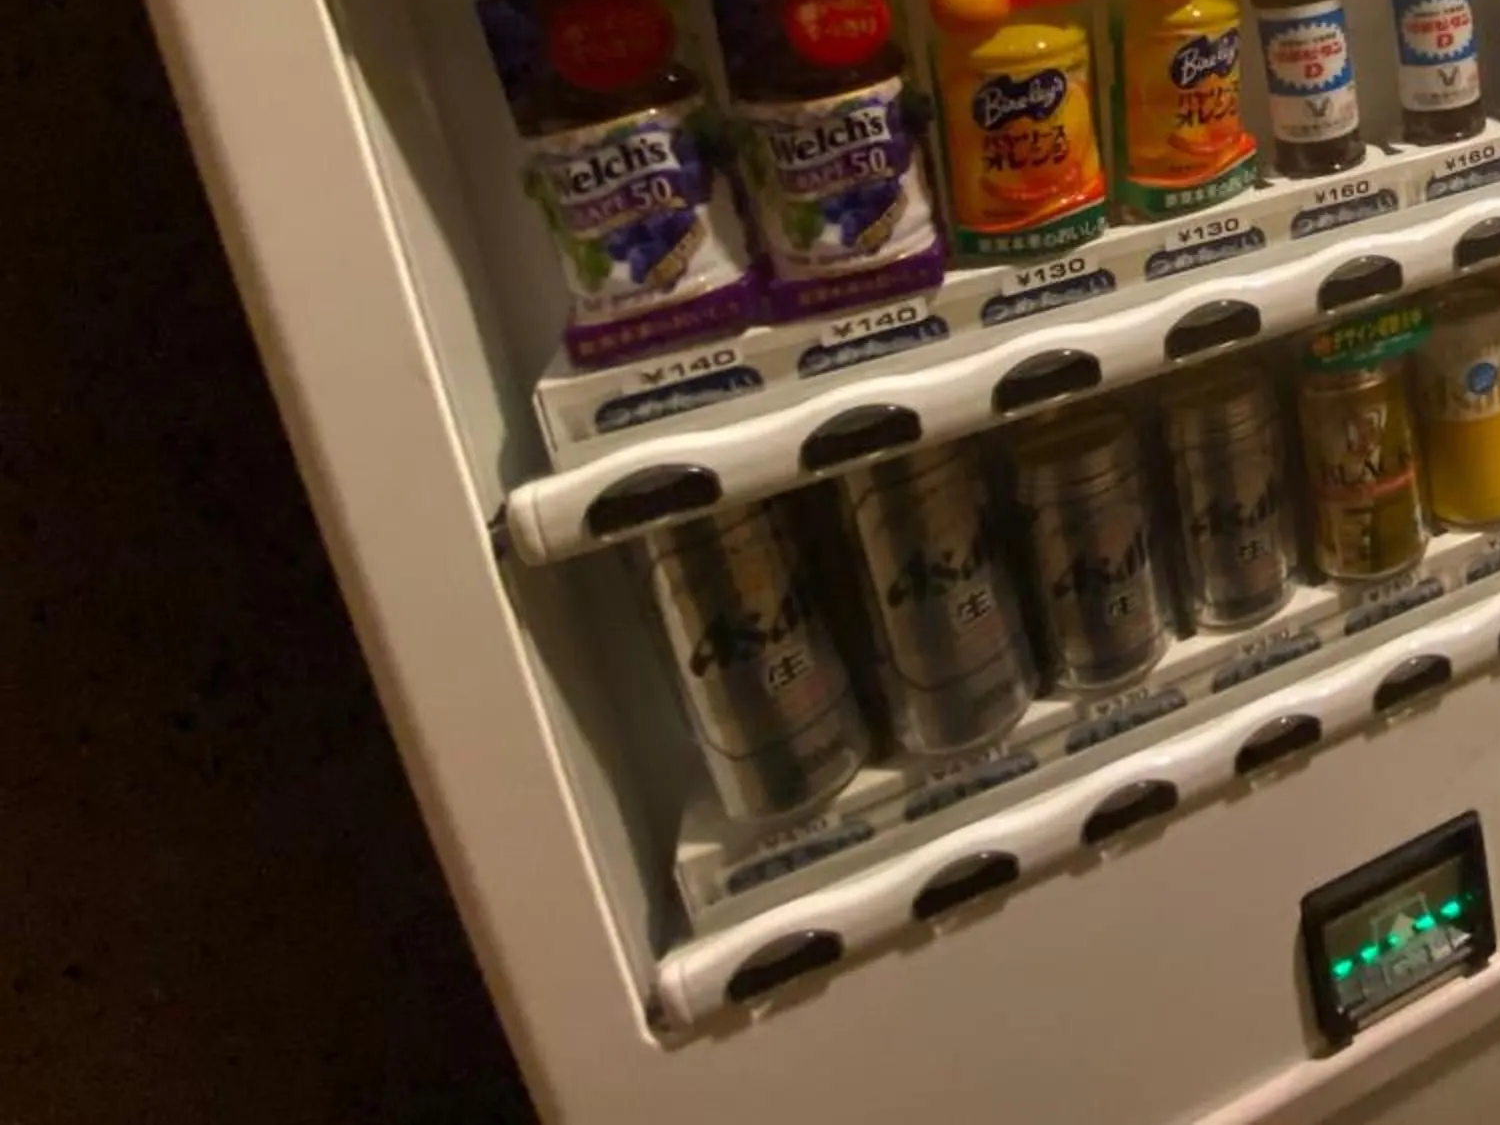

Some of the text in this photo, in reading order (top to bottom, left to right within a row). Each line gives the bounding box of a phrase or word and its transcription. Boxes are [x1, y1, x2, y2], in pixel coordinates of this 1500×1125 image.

[769, 113, 884, 166] Welch's
[849, 146, 887, 175] 50
[630, 176, 673, 210] 50
[1177, 217, 1240, 243] ¥130
[1016, 257, 1086, 286] ¥130
[831, 306, 918, 339] ¥140
[638, 348, 737, 384] ¥140
